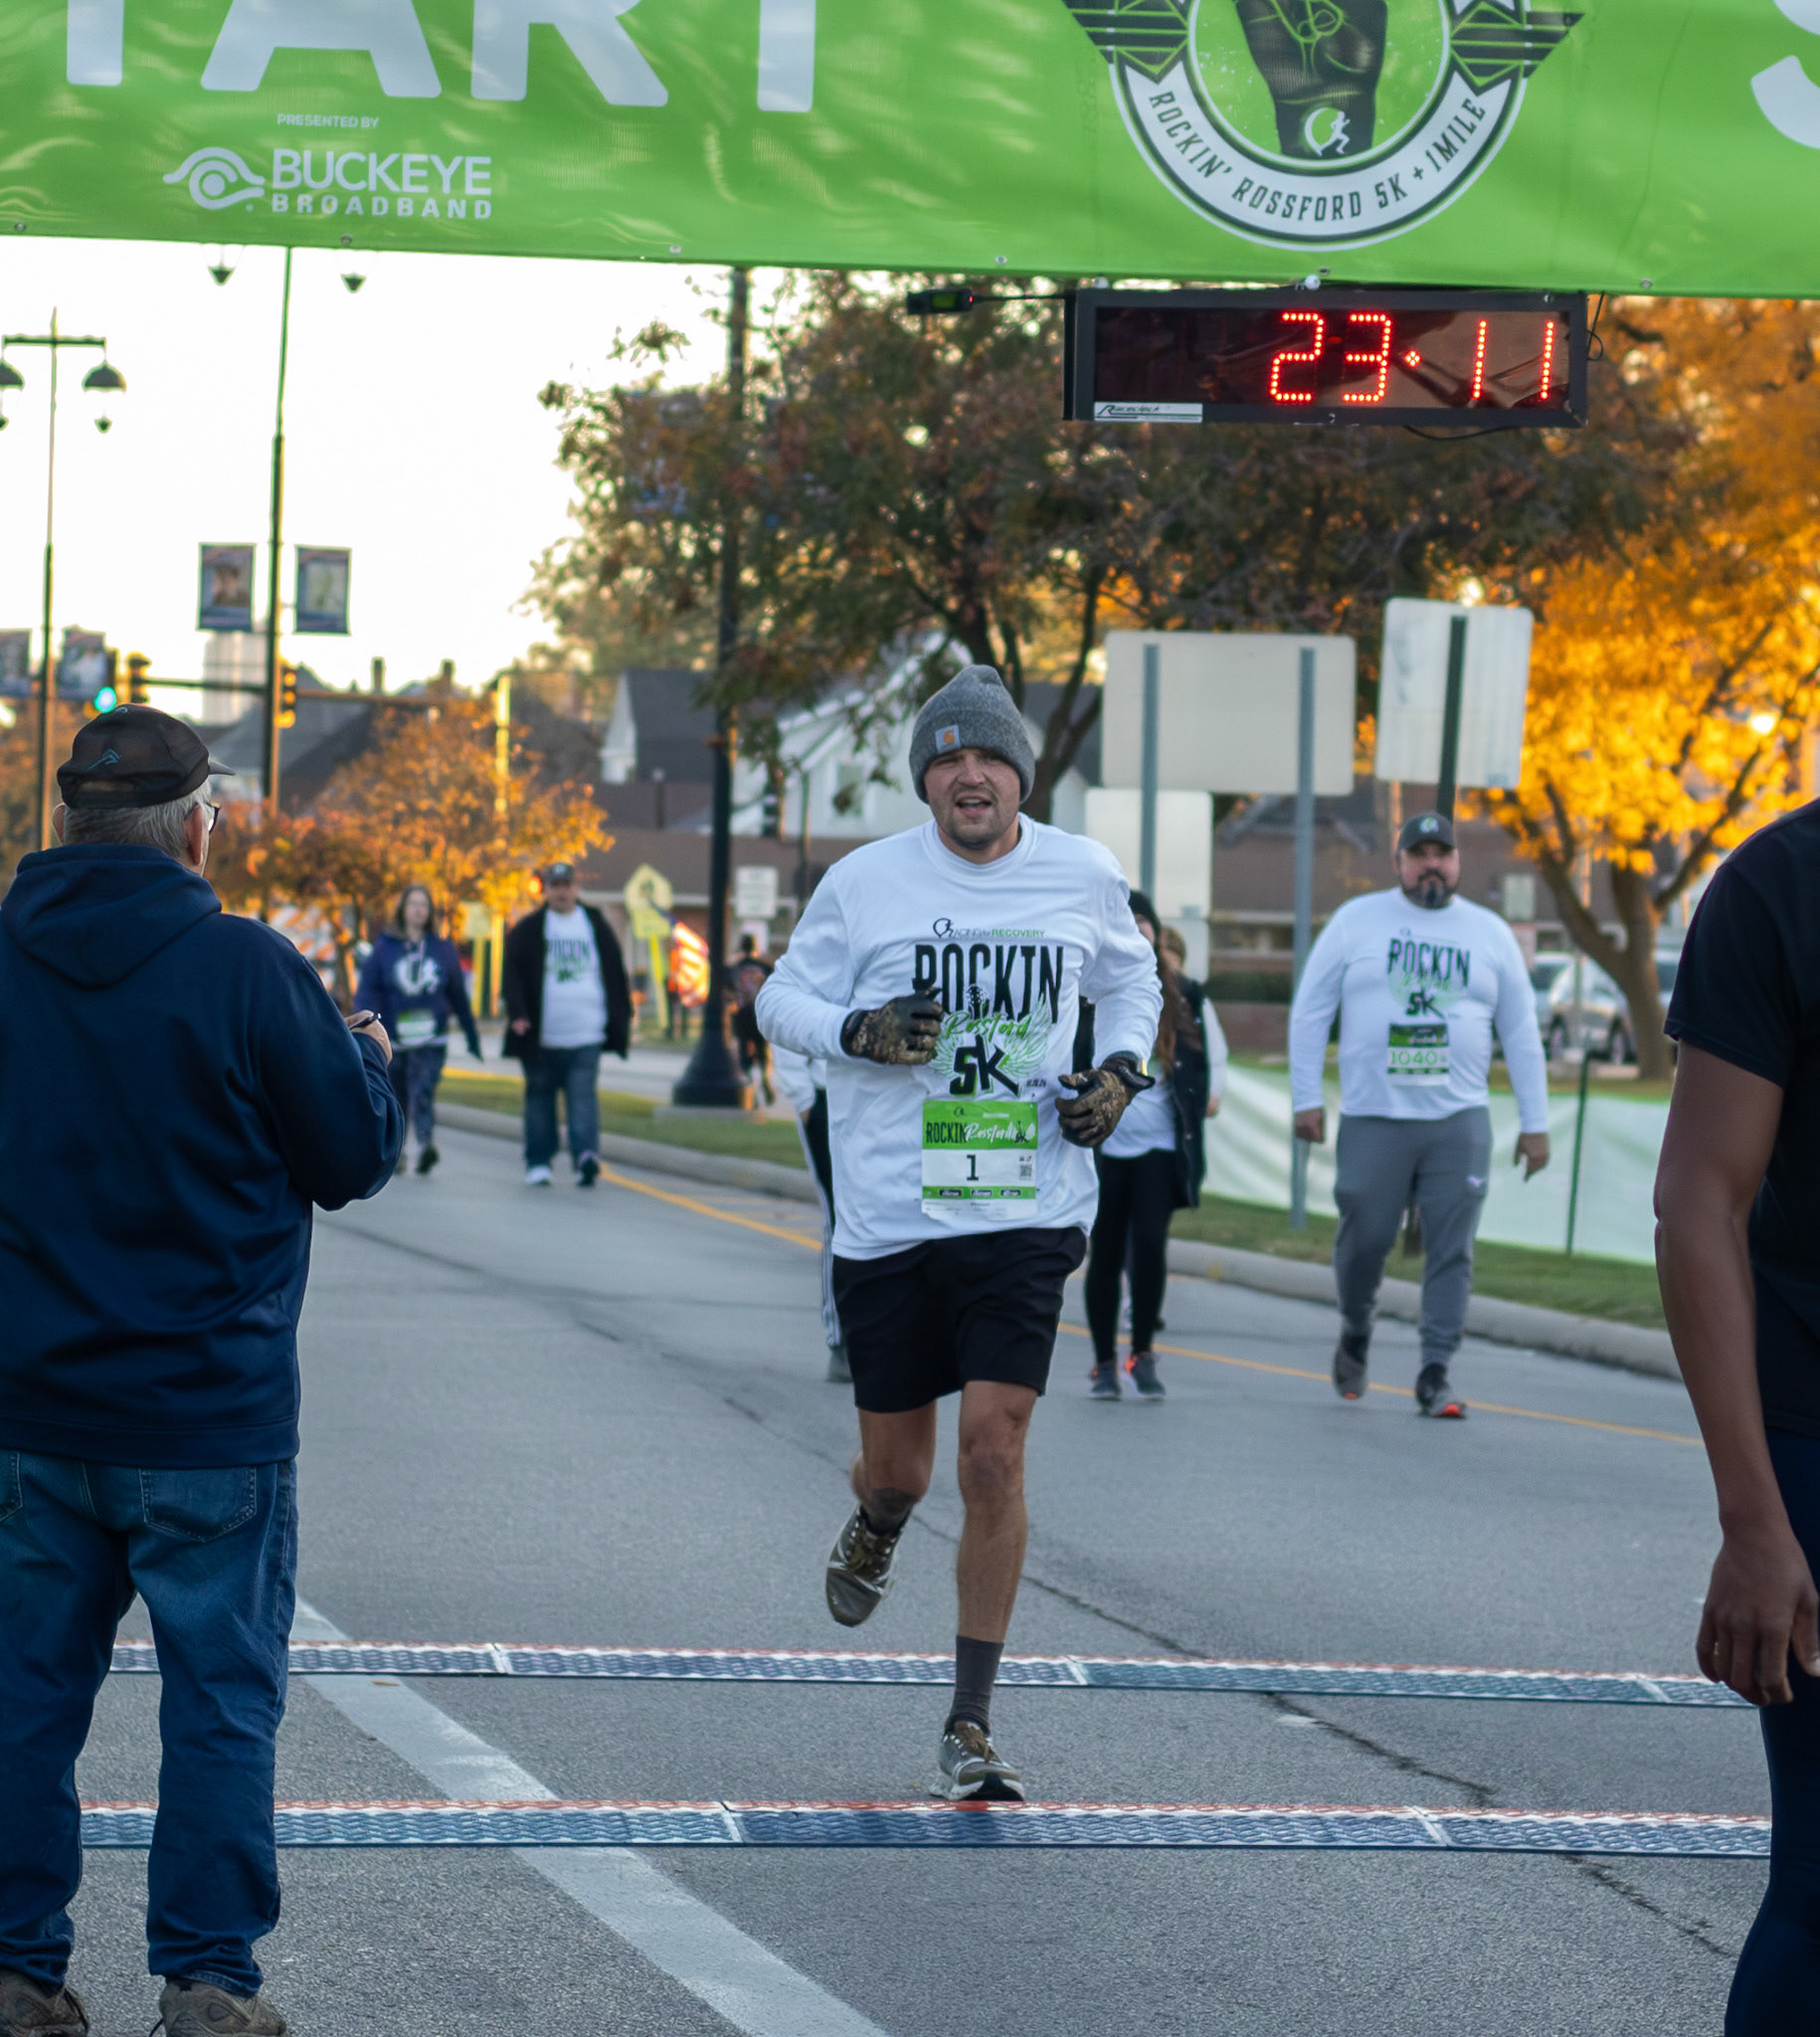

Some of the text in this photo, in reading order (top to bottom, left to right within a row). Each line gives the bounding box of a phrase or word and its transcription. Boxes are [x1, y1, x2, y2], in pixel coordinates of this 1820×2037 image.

[276, 113, 379, 128] PRESENTED BY
[273, 149, 492, 196] BUCKEYE
[272, 193, 492, 220] BROADBAND
[1231, 177, 1362, 222] ROSSFORD
[1374, 173, 1408, 210] 5K
[992, 929, 1045, 938] RECOVERY
[1387, 938, 1471, 988] ROCKIN
[912, 943, 1064, 1024] ROCKIN
[1406, 989, 1446, 1019] 5K
[944, 1010, 1032, 1043] Rossford
[949, 1033, 1020, 1099] 5K
[926, 1121, 968, 1145] ROCKIN
[966, 1154, 980, 1182] 1
